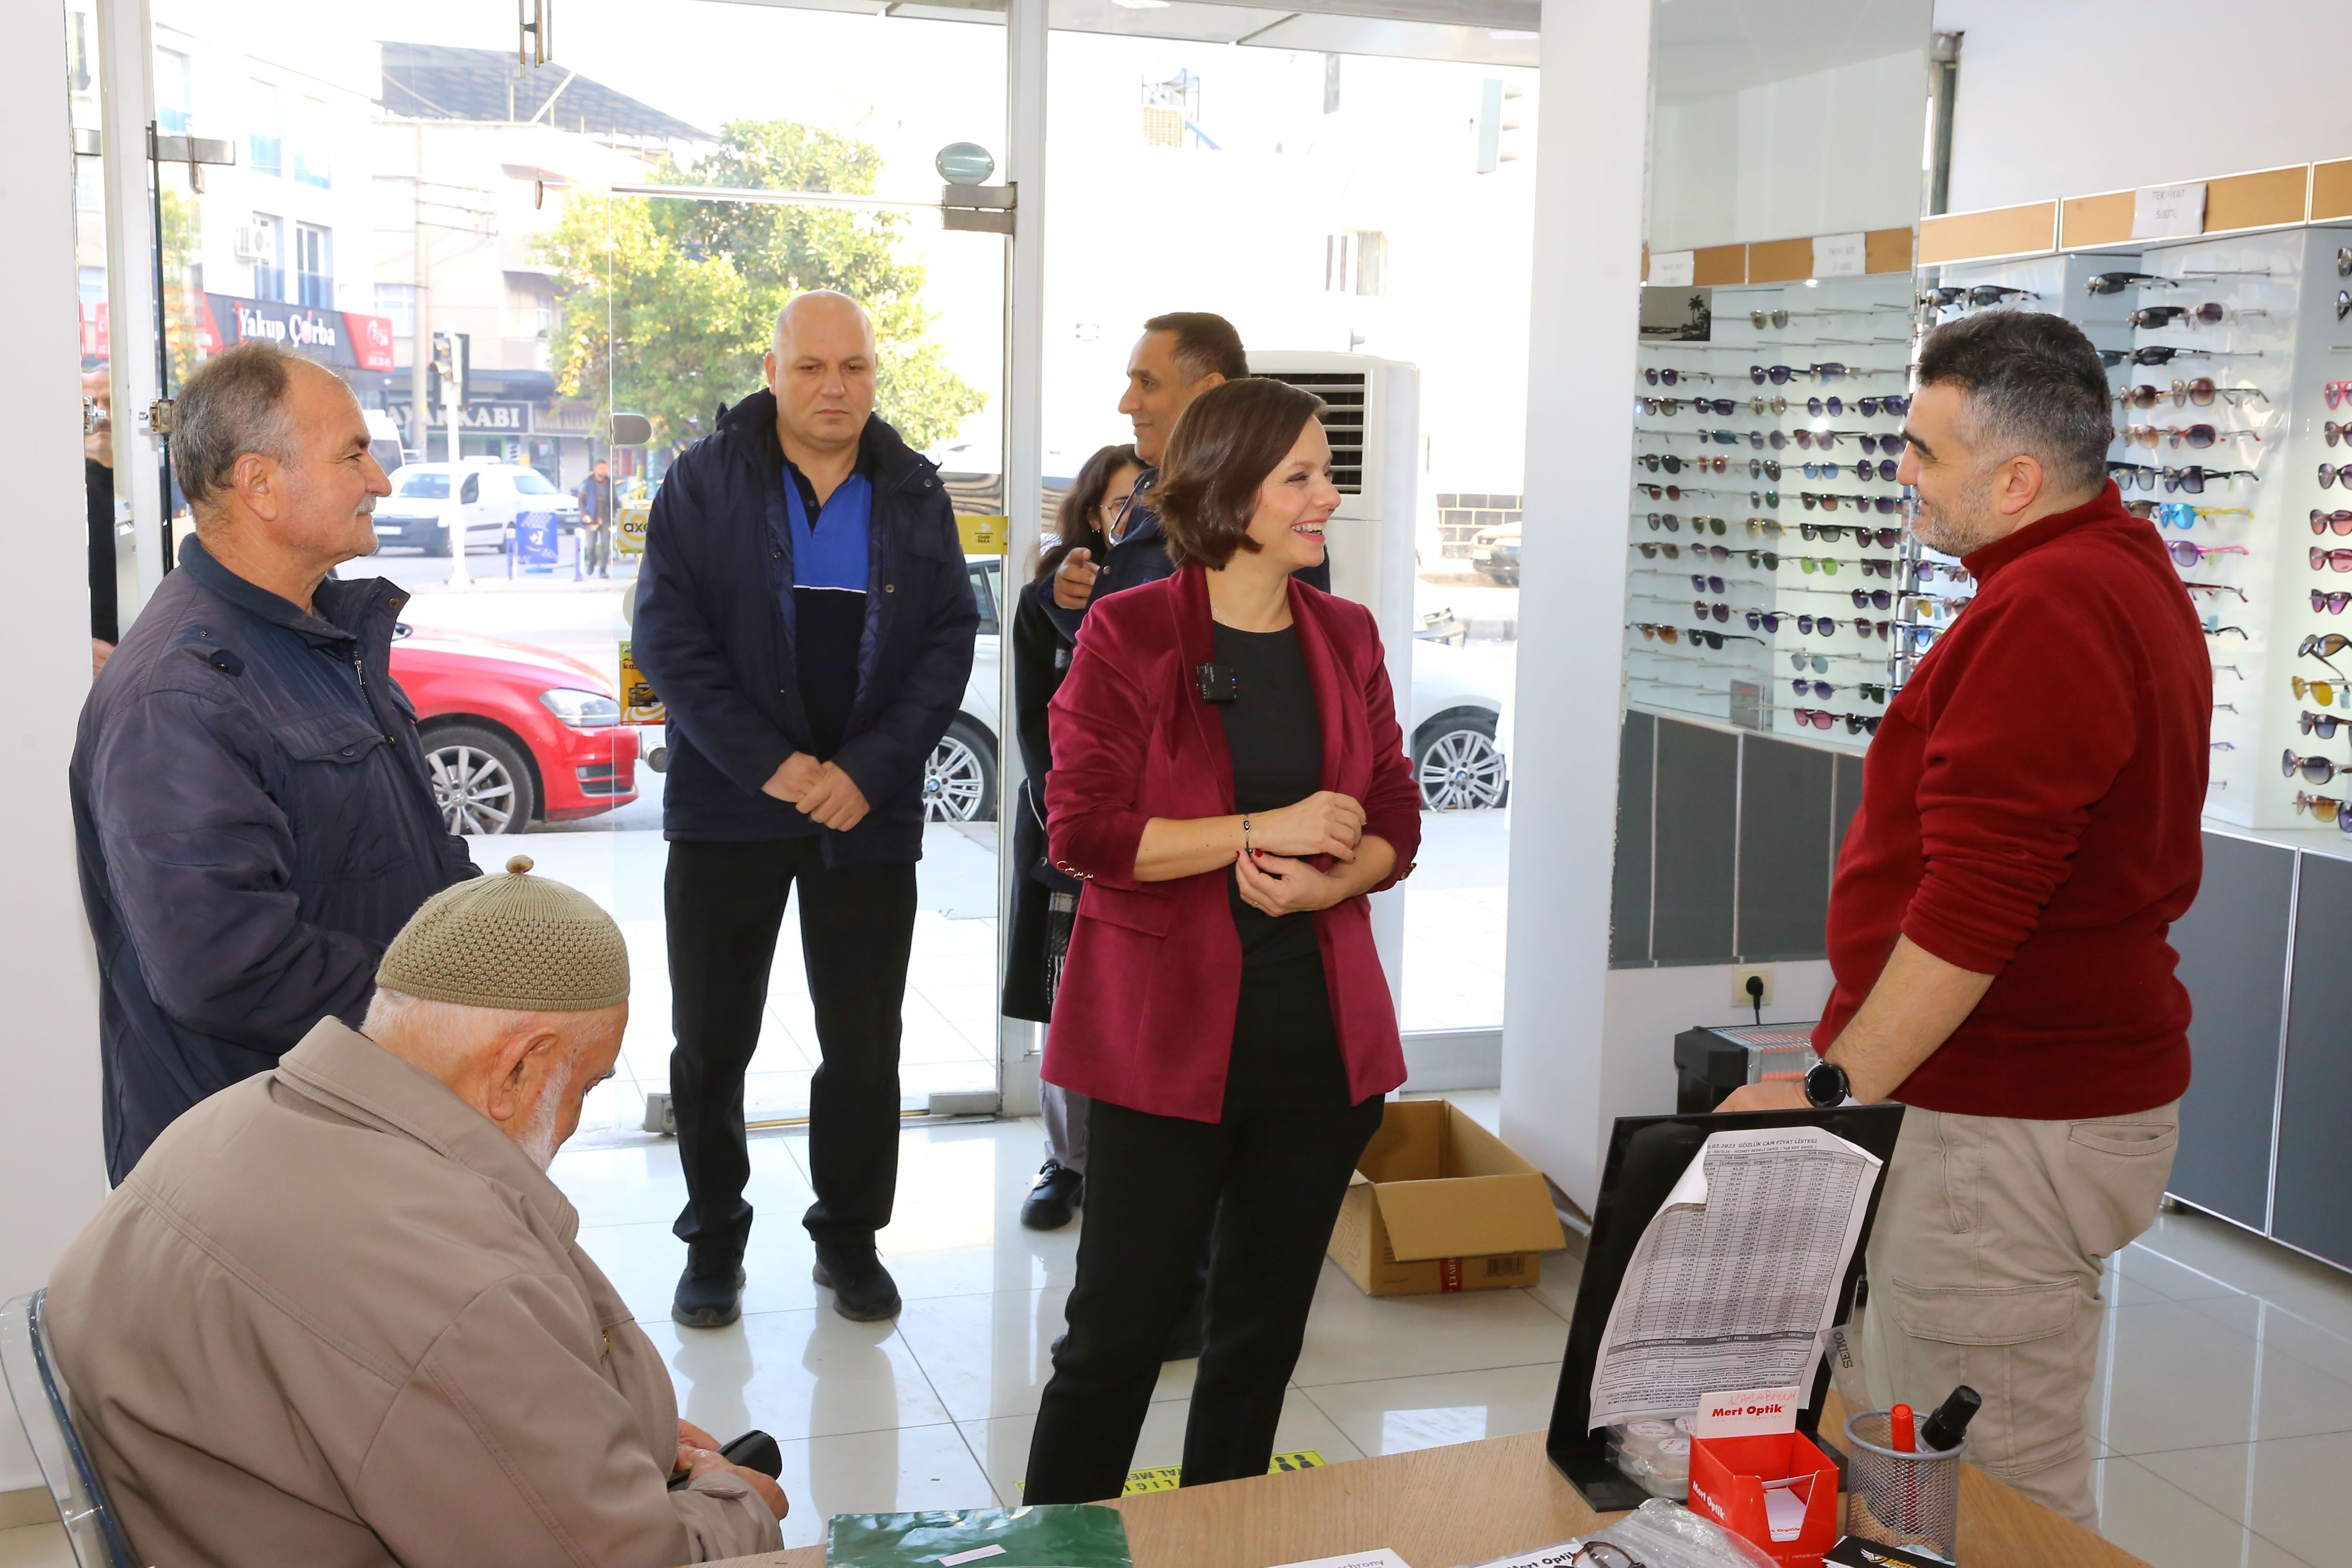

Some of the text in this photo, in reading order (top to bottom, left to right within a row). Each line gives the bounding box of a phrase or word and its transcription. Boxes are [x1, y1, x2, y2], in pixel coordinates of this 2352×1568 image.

[239, 307, 335, 348] Yakup Çorba
[1449, 1259, 1458, 1287] ERVET
[1834, 1332, 1853, 1369] SEIKO
[1712, 1404, 1782, 1417] Mert Optik
[1692, 1480, 1725, 1520] Mert Optik
